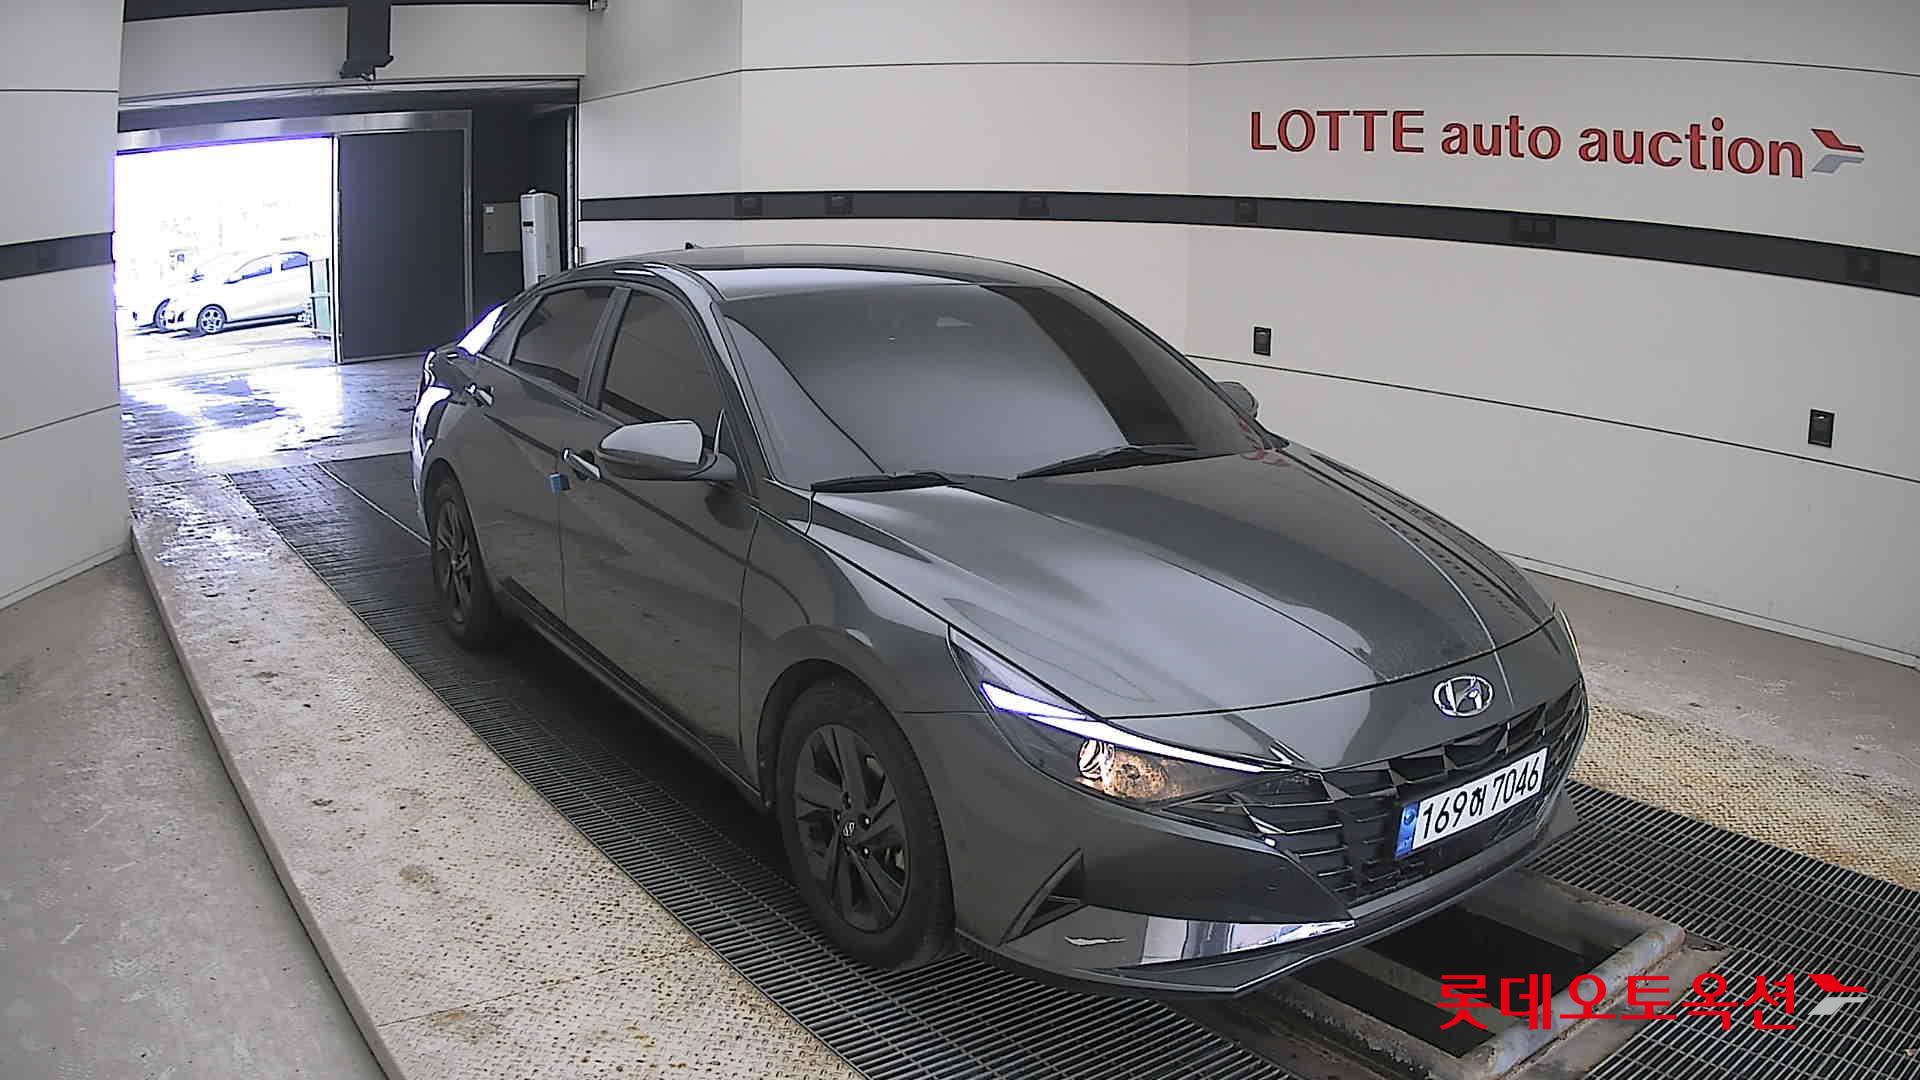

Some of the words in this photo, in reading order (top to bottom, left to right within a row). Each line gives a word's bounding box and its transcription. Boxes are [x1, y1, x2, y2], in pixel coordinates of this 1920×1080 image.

[1250, 110, 1424, 151] LOTTE
[1442, 116, 1562, 161] auto
[1578, 118, 1803, 178] auction
[1422, 784, 1487, 839] 169허
[1491, 757, 1540, 811] 7046
